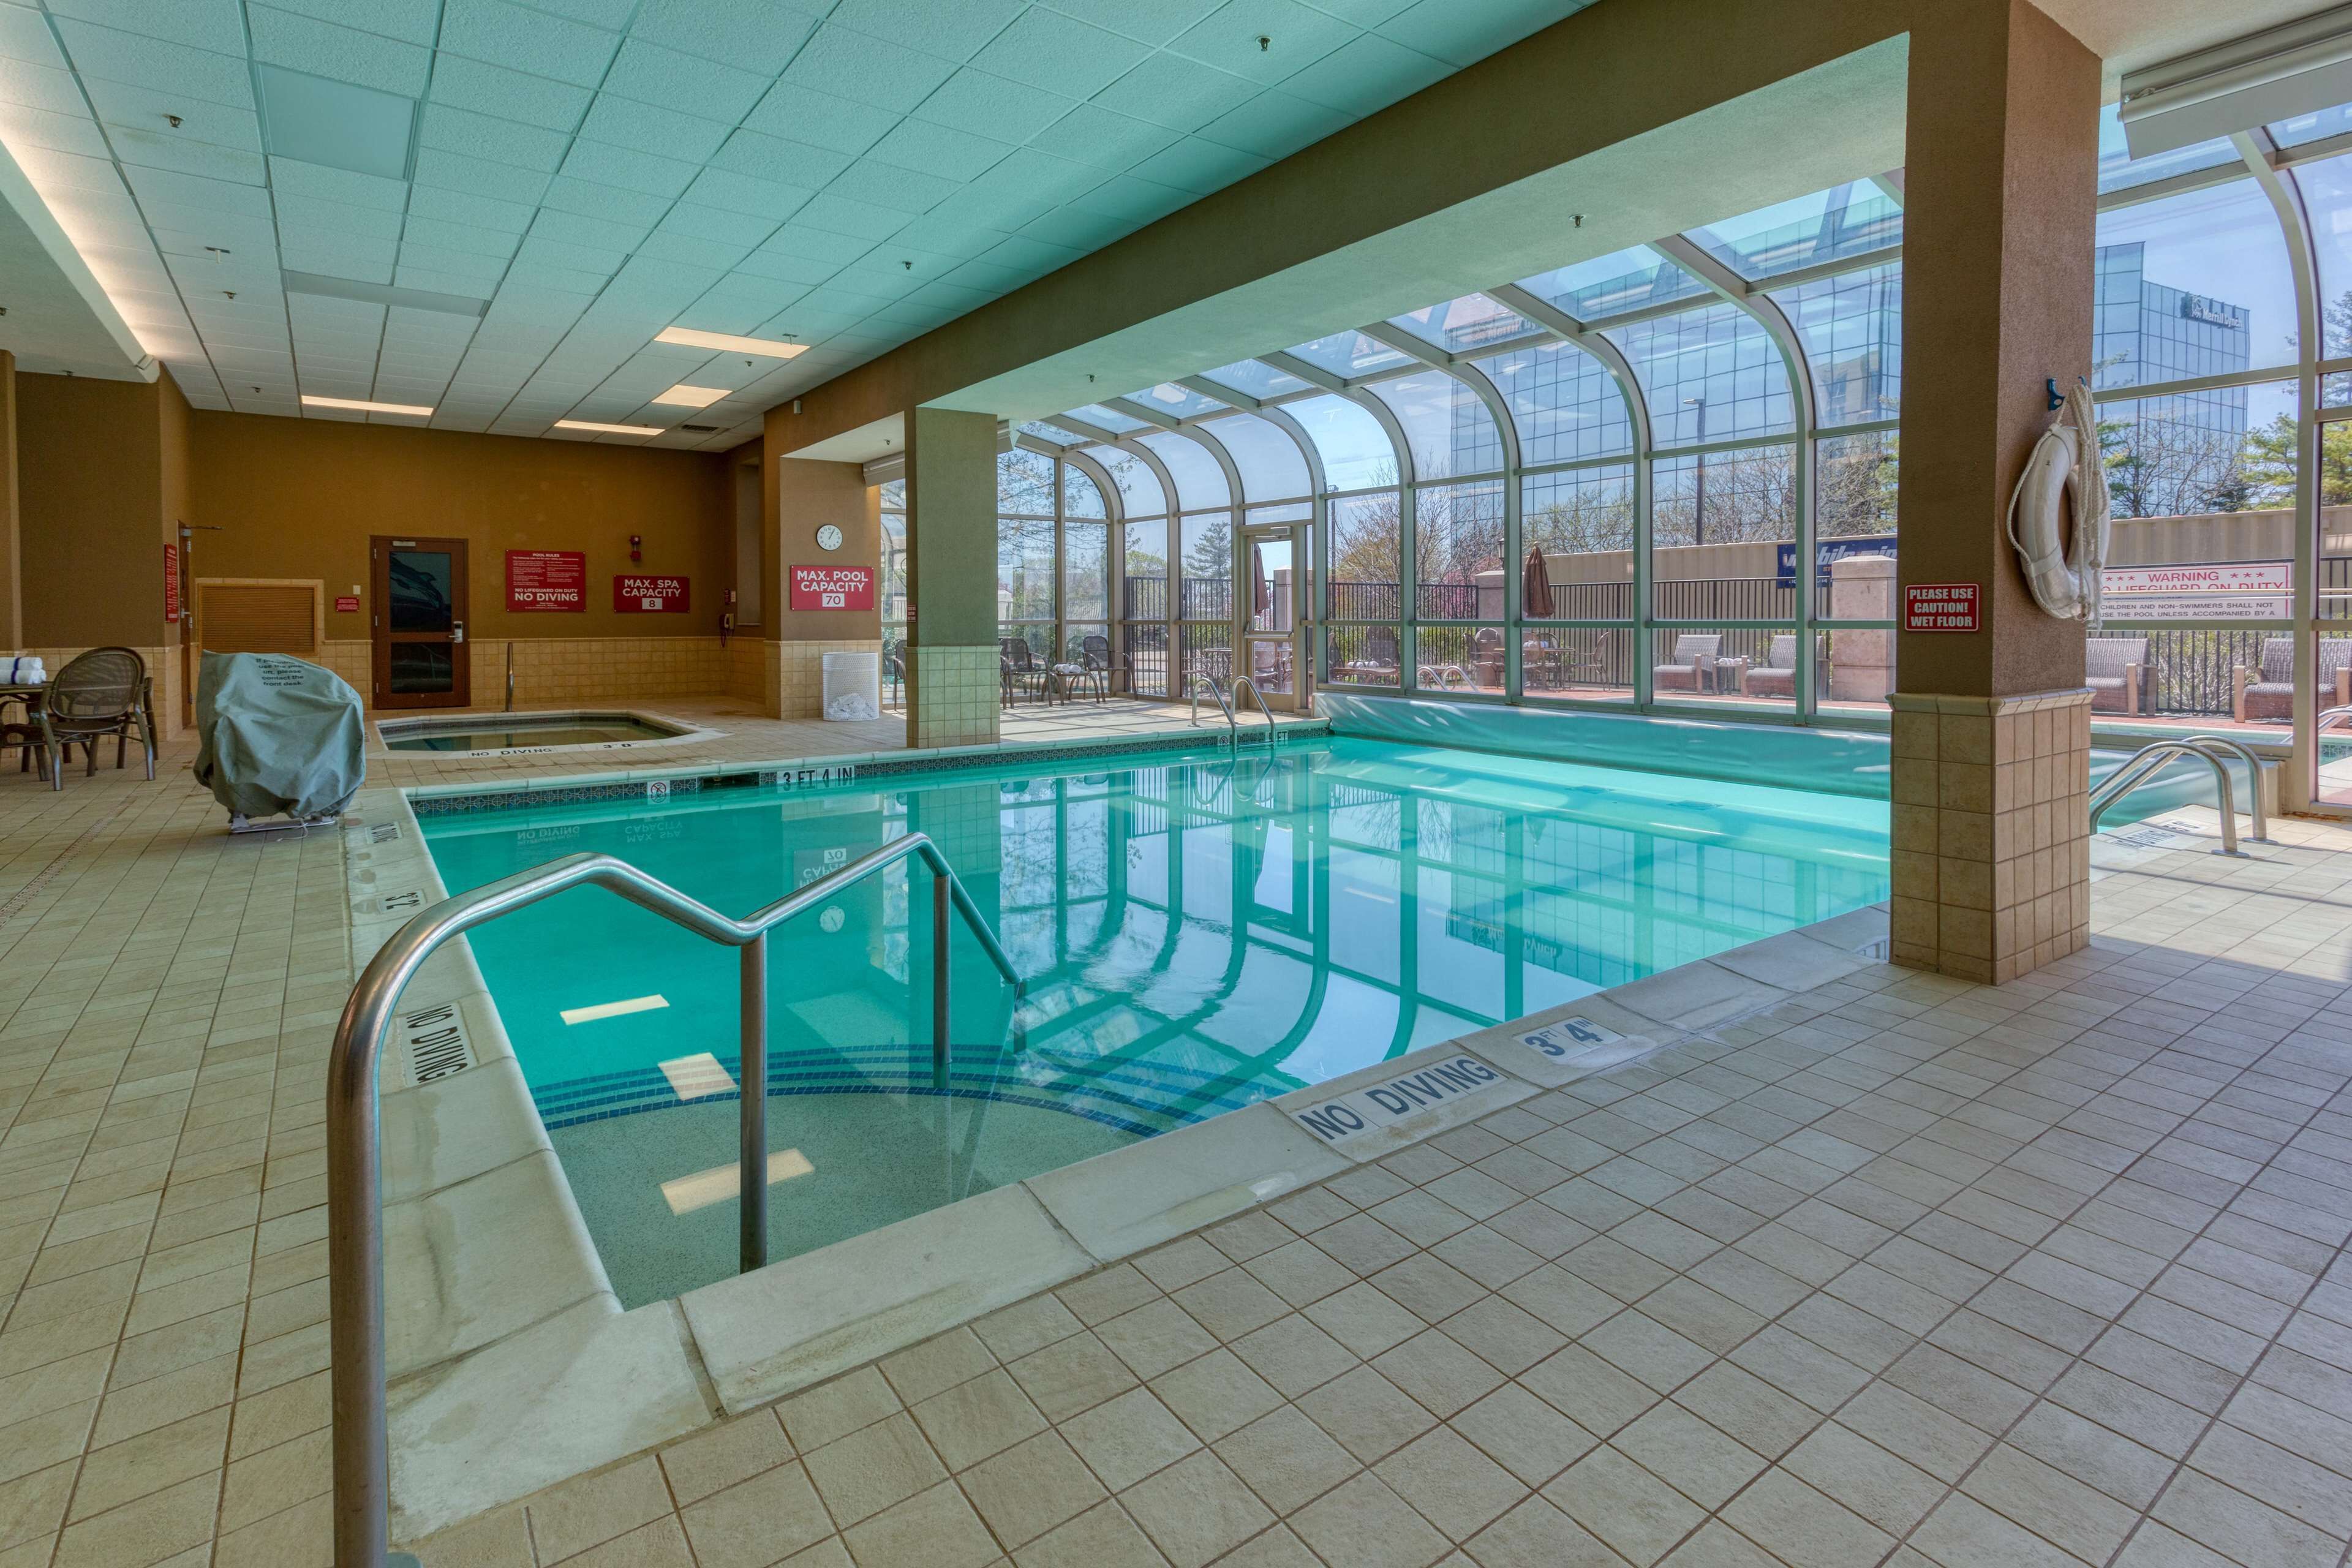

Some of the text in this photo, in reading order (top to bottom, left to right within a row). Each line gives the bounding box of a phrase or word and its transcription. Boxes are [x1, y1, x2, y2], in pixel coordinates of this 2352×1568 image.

[797, 571, 869, 581] MAX. POOL
[2147, 571, 2219, 582] WARNING
[624, 579, 679, 588] MAX. SPA
[801, 582, 865, 592] CAPACITY
[514, 592, 578, 601] NO DIVING
[622, 588, 681, 597] CAPACITY
[1909, 588, 1973, 600] PLEASE USE
[826, 595, 841, 605] 70
[1914, 602, 1969, 613] CAUTION!
[1910, 616, 1972, 627] WET FLOOR
[838, 767, 852, 778] IN
[406, 1005, 468, 1084] NO DIVING
[1298, 1058, 1499, 1140] NO DIVING
